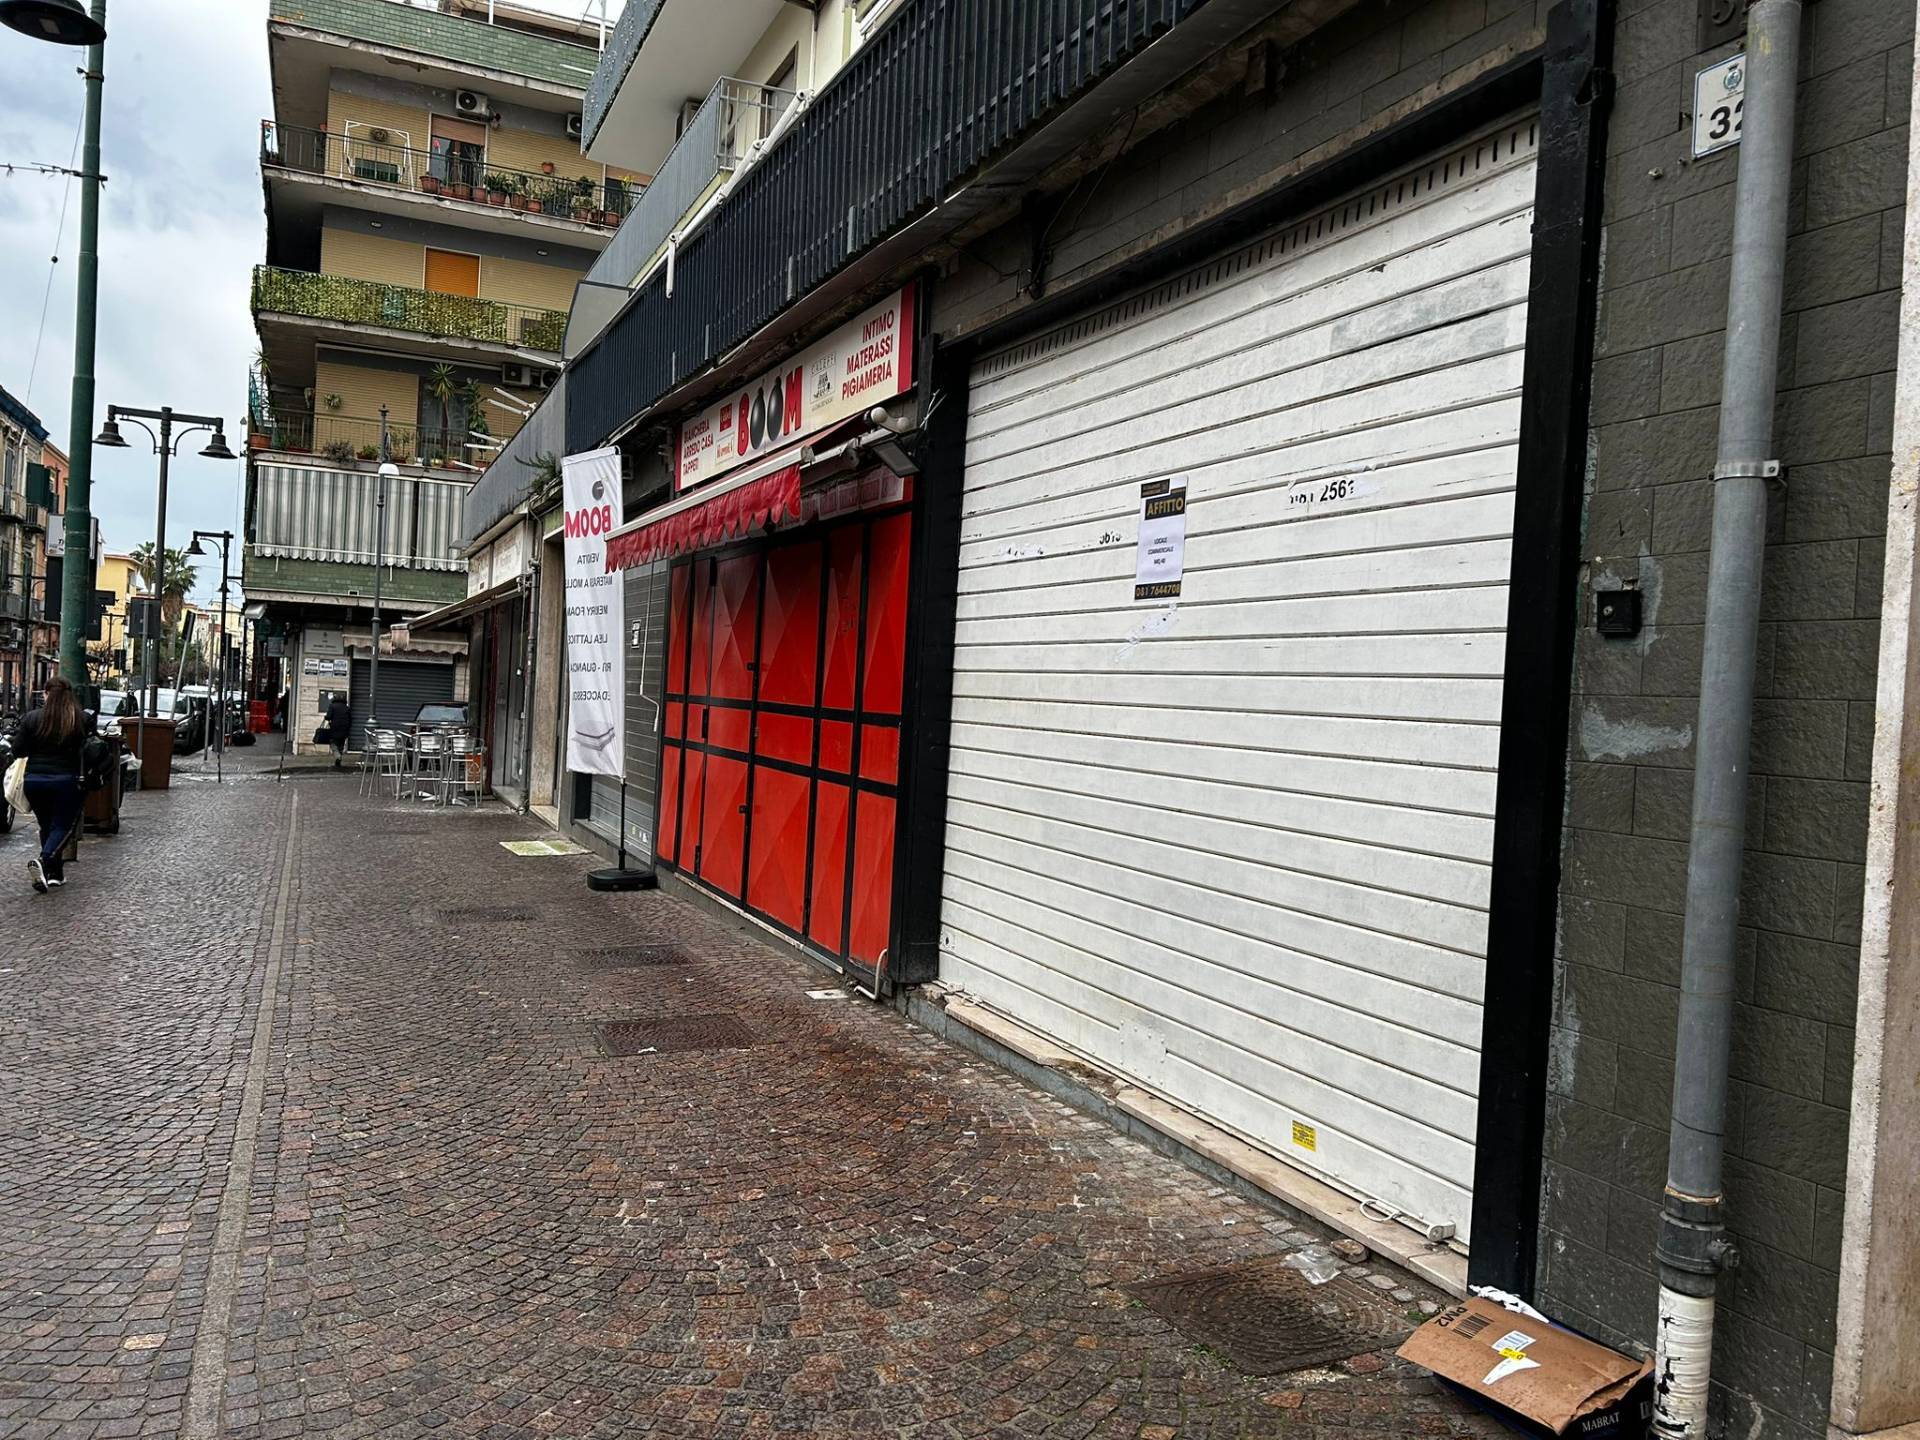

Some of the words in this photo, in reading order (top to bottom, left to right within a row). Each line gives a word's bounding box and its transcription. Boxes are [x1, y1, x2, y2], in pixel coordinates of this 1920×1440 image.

[862, 309, 895, 343] INTIMO
[846, 334, 893, 375] MATERASSI
[842, 359, 892, 400] PIGIAMERIA
[1147, 497, 1184, 517] AFFITTO
[1136, 586, 1148, 597] 081
